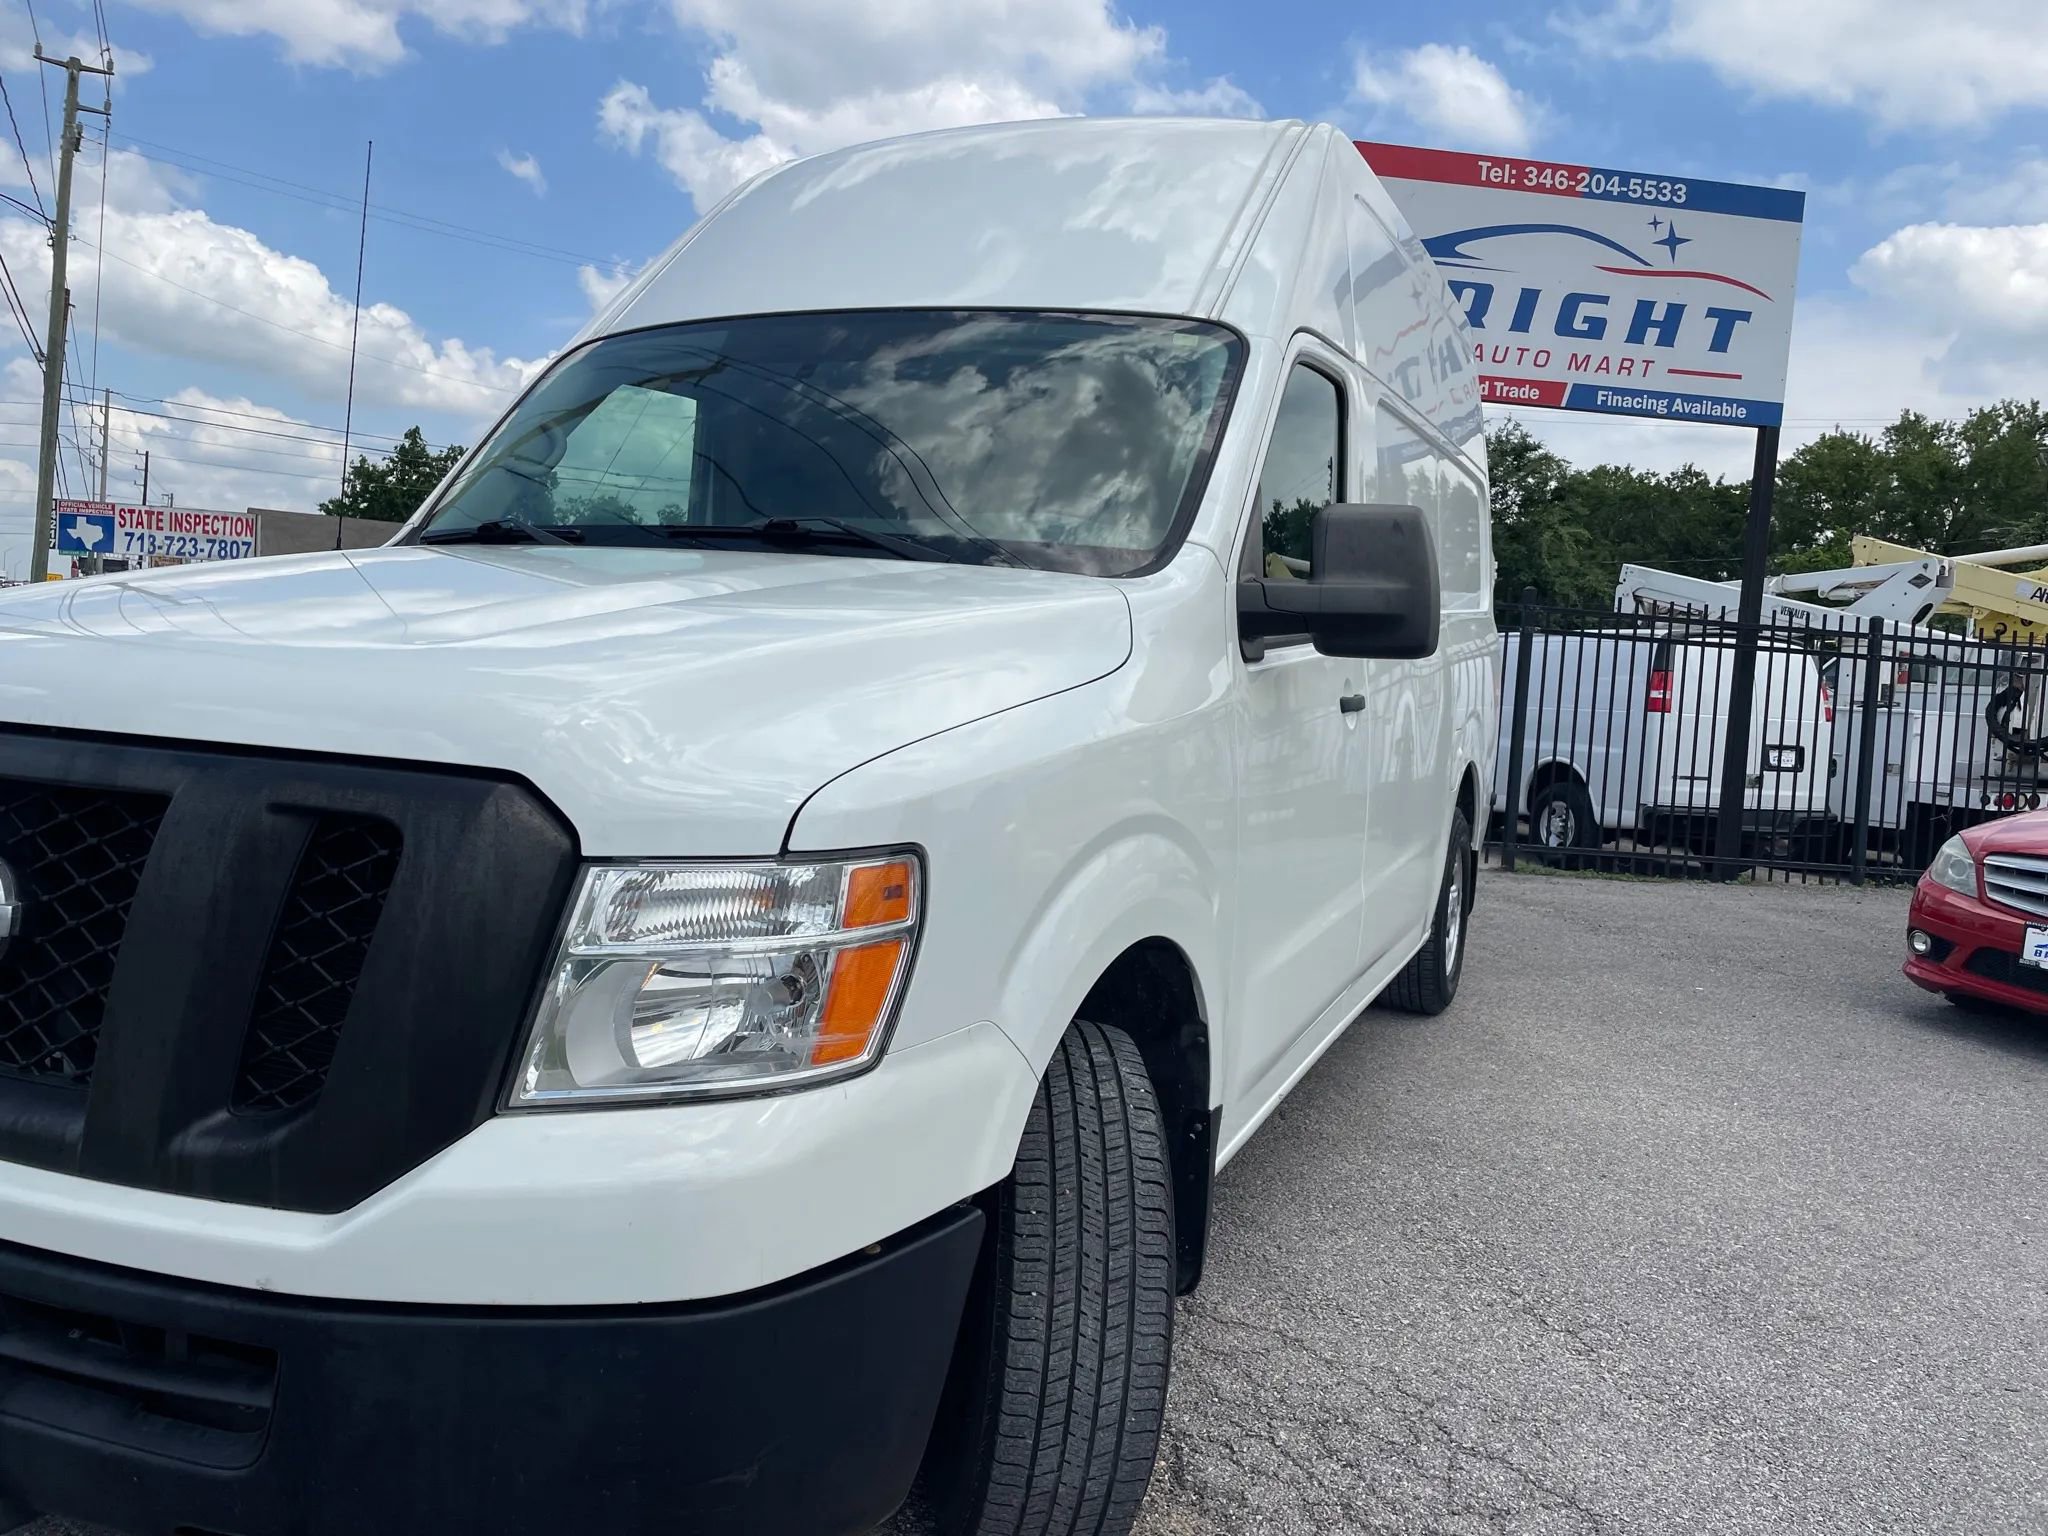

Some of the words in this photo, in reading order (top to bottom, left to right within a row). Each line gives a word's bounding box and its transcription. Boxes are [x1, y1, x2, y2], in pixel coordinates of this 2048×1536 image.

[1478, 161, 1517, 185] Tel:
[1523, 166, 1687, 204] 346-204-5533
[1447, 280, 1752, 353] RIGHT
[1475, 343, 1551, 368] AUTO
[1567, 352, 1655, 378] MART
[1494, 381, 1540, 400] Trade
[1597, 390, 1668, 415] Finacing
[1671, 400, 1747, 419] Available
[118, 507, 164, 531] STATE
[169, 511, 254, 538] INSPECTION
[124, 532, 252, 560] 713-723-7807
[1780, 605, 1809, 620] VERSALIF
